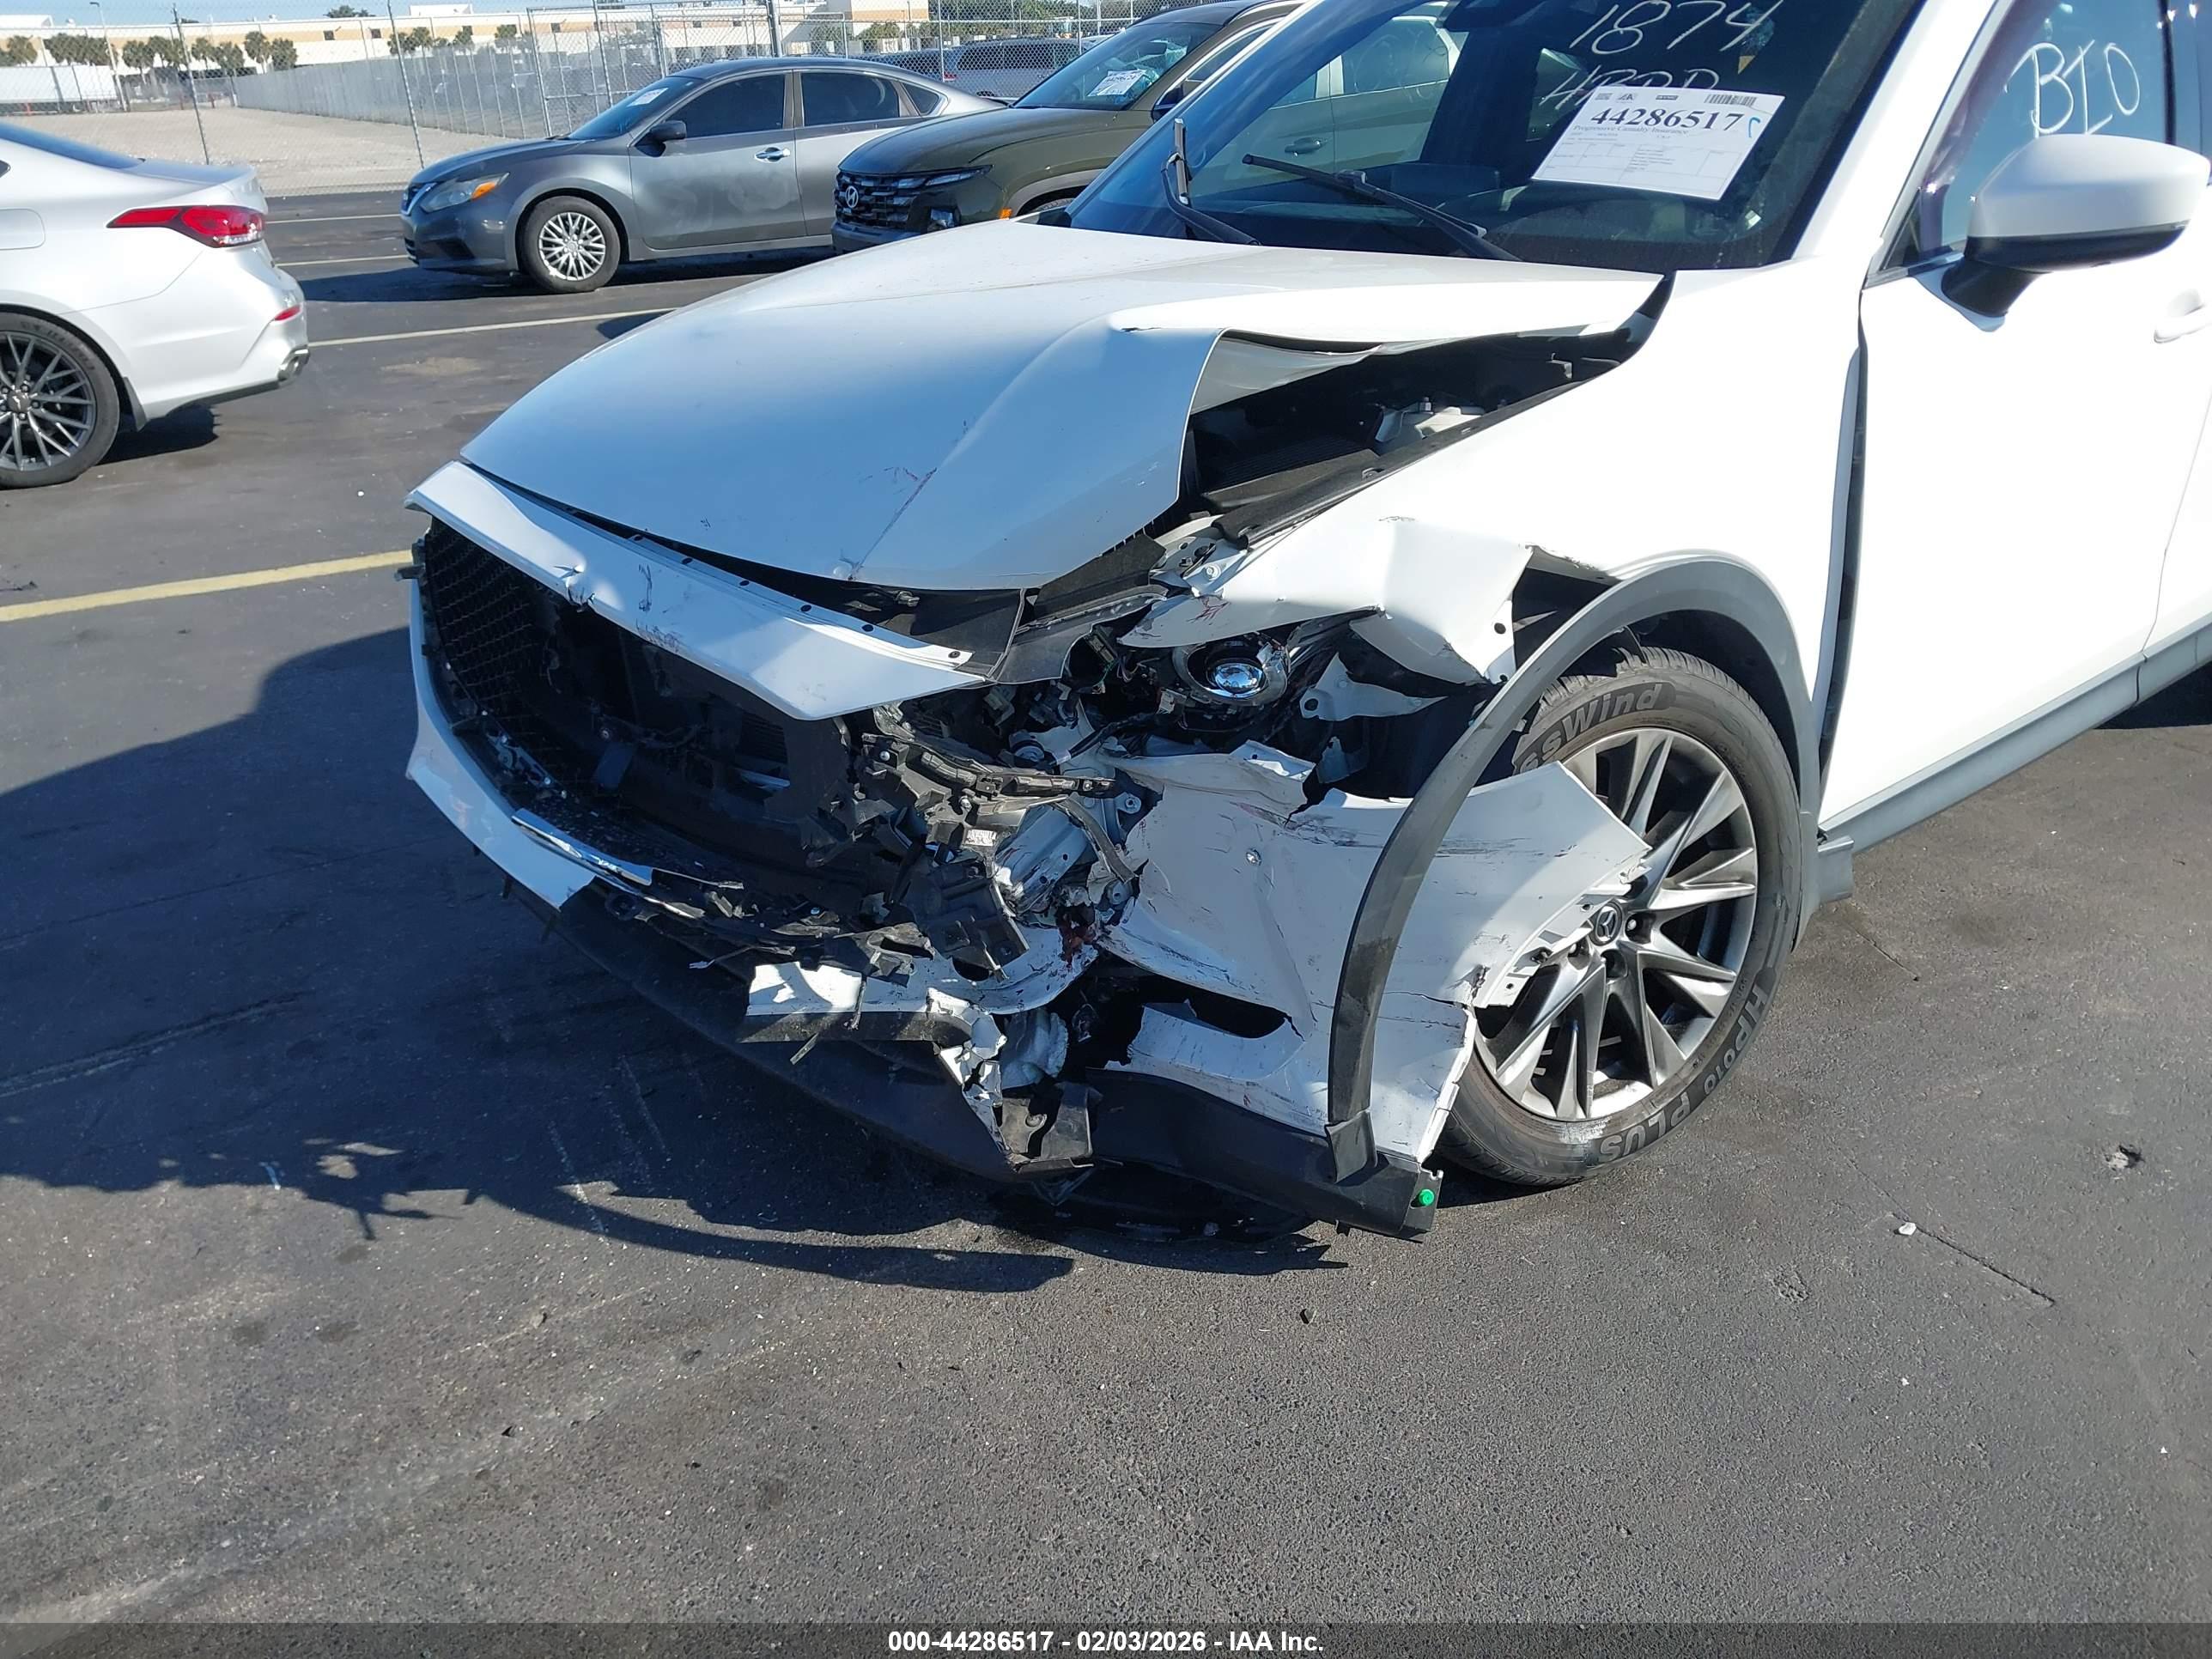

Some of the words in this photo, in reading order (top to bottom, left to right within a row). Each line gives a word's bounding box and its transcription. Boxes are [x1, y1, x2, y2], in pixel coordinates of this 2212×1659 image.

[1570, 0, 1784, 54] 1874
[1591, 107, 1744, 131] 44286517
[1704, 983, 1769, 1096] HP010
[1600, 1091, 1691, 1161] PLUS
